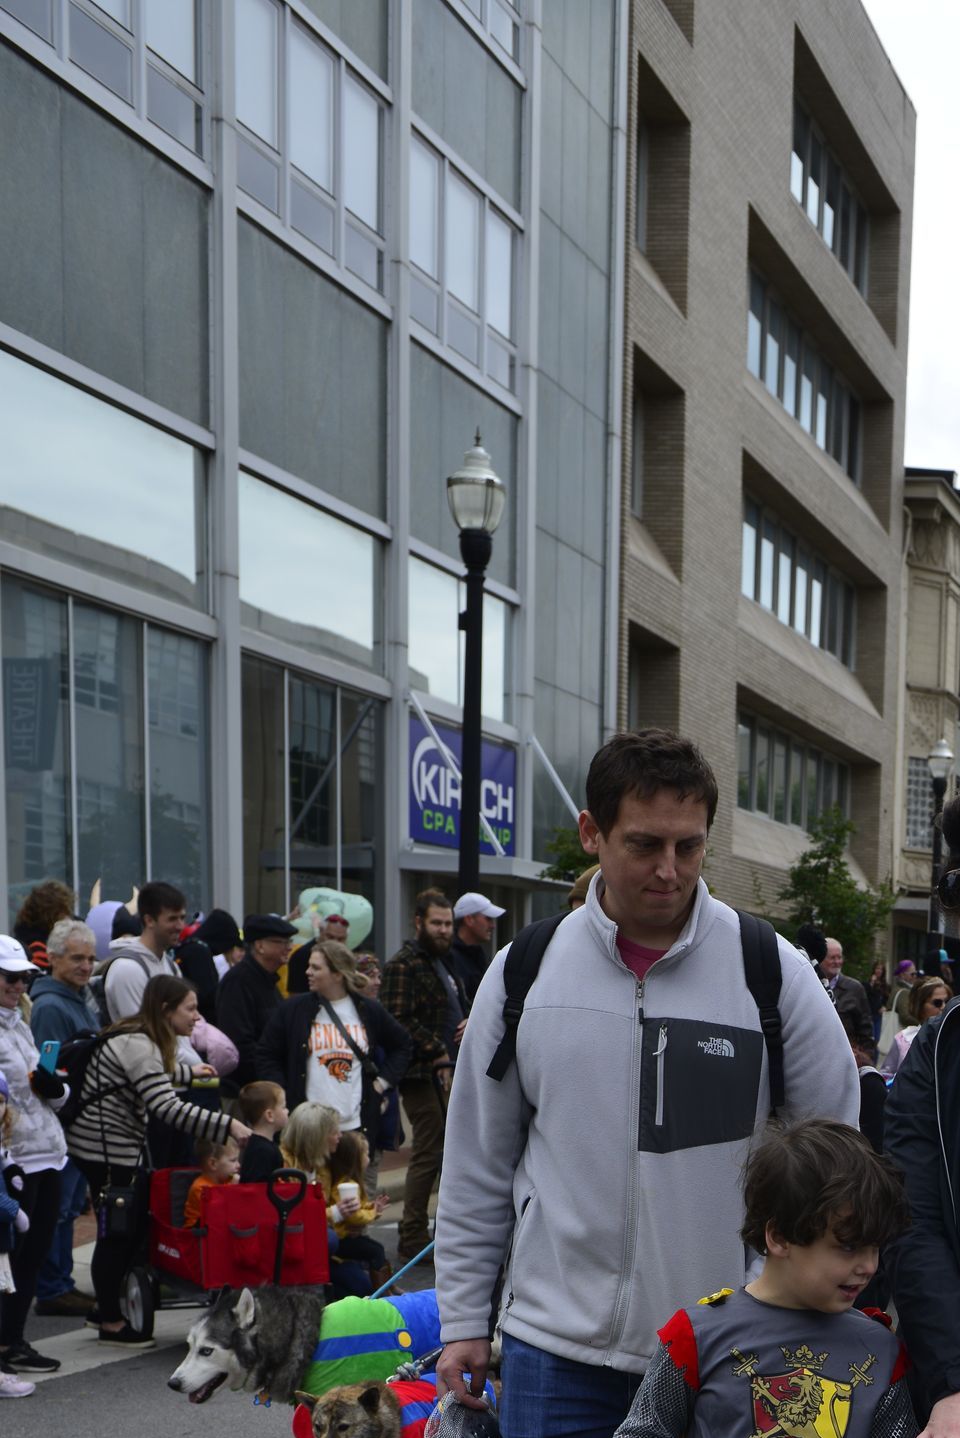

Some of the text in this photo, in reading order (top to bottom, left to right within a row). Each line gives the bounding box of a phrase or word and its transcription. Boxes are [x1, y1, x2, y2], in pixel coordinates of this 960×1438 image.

[419, 760, 513, 823] KIRCH
[422, 809, 456, 835] CPA
[697, 1040, 723, 1050] NORTH
[709, 1036, 723, 1045] THE
[704, 1047, 722, 1056] FACE
